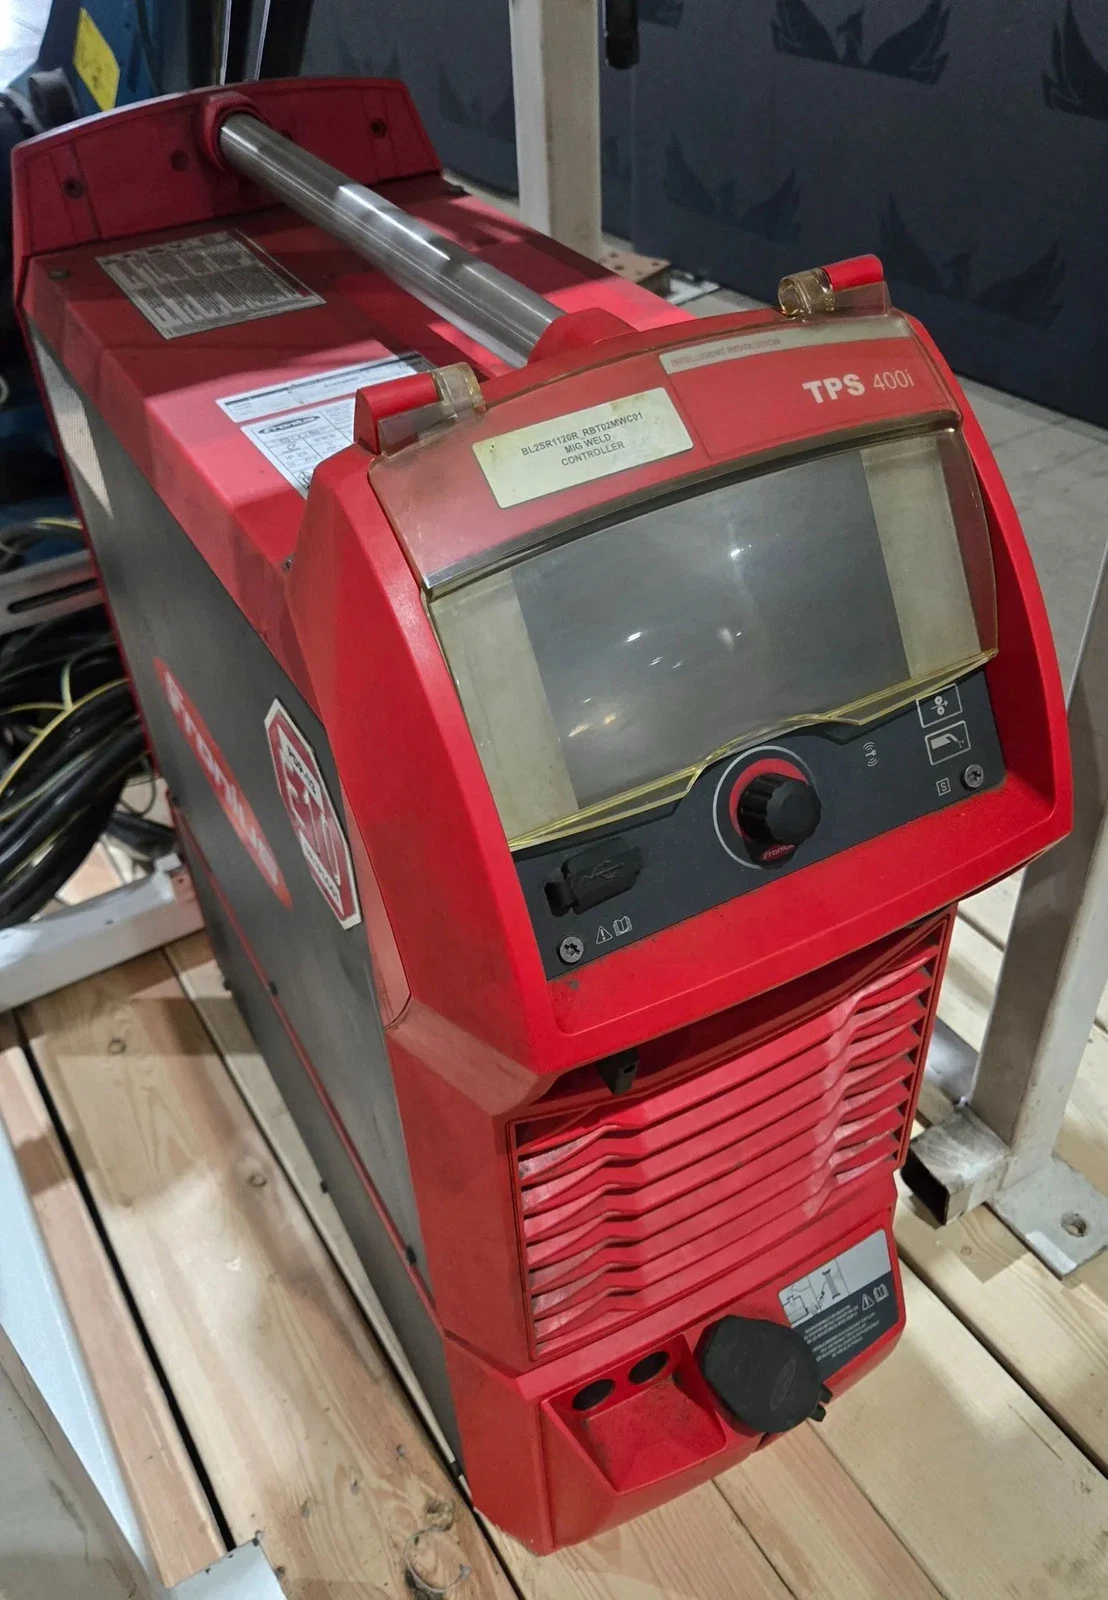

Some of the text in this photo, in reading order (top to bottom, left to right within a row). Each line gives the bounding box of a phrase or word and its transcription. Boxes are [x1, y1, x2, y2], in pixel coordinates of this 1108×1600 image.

[802, 369, 915, 404] TPS 400i
[561, 440, 625, 467] CONTROLLER
[564, 433, 612, 455] MIG WELD
